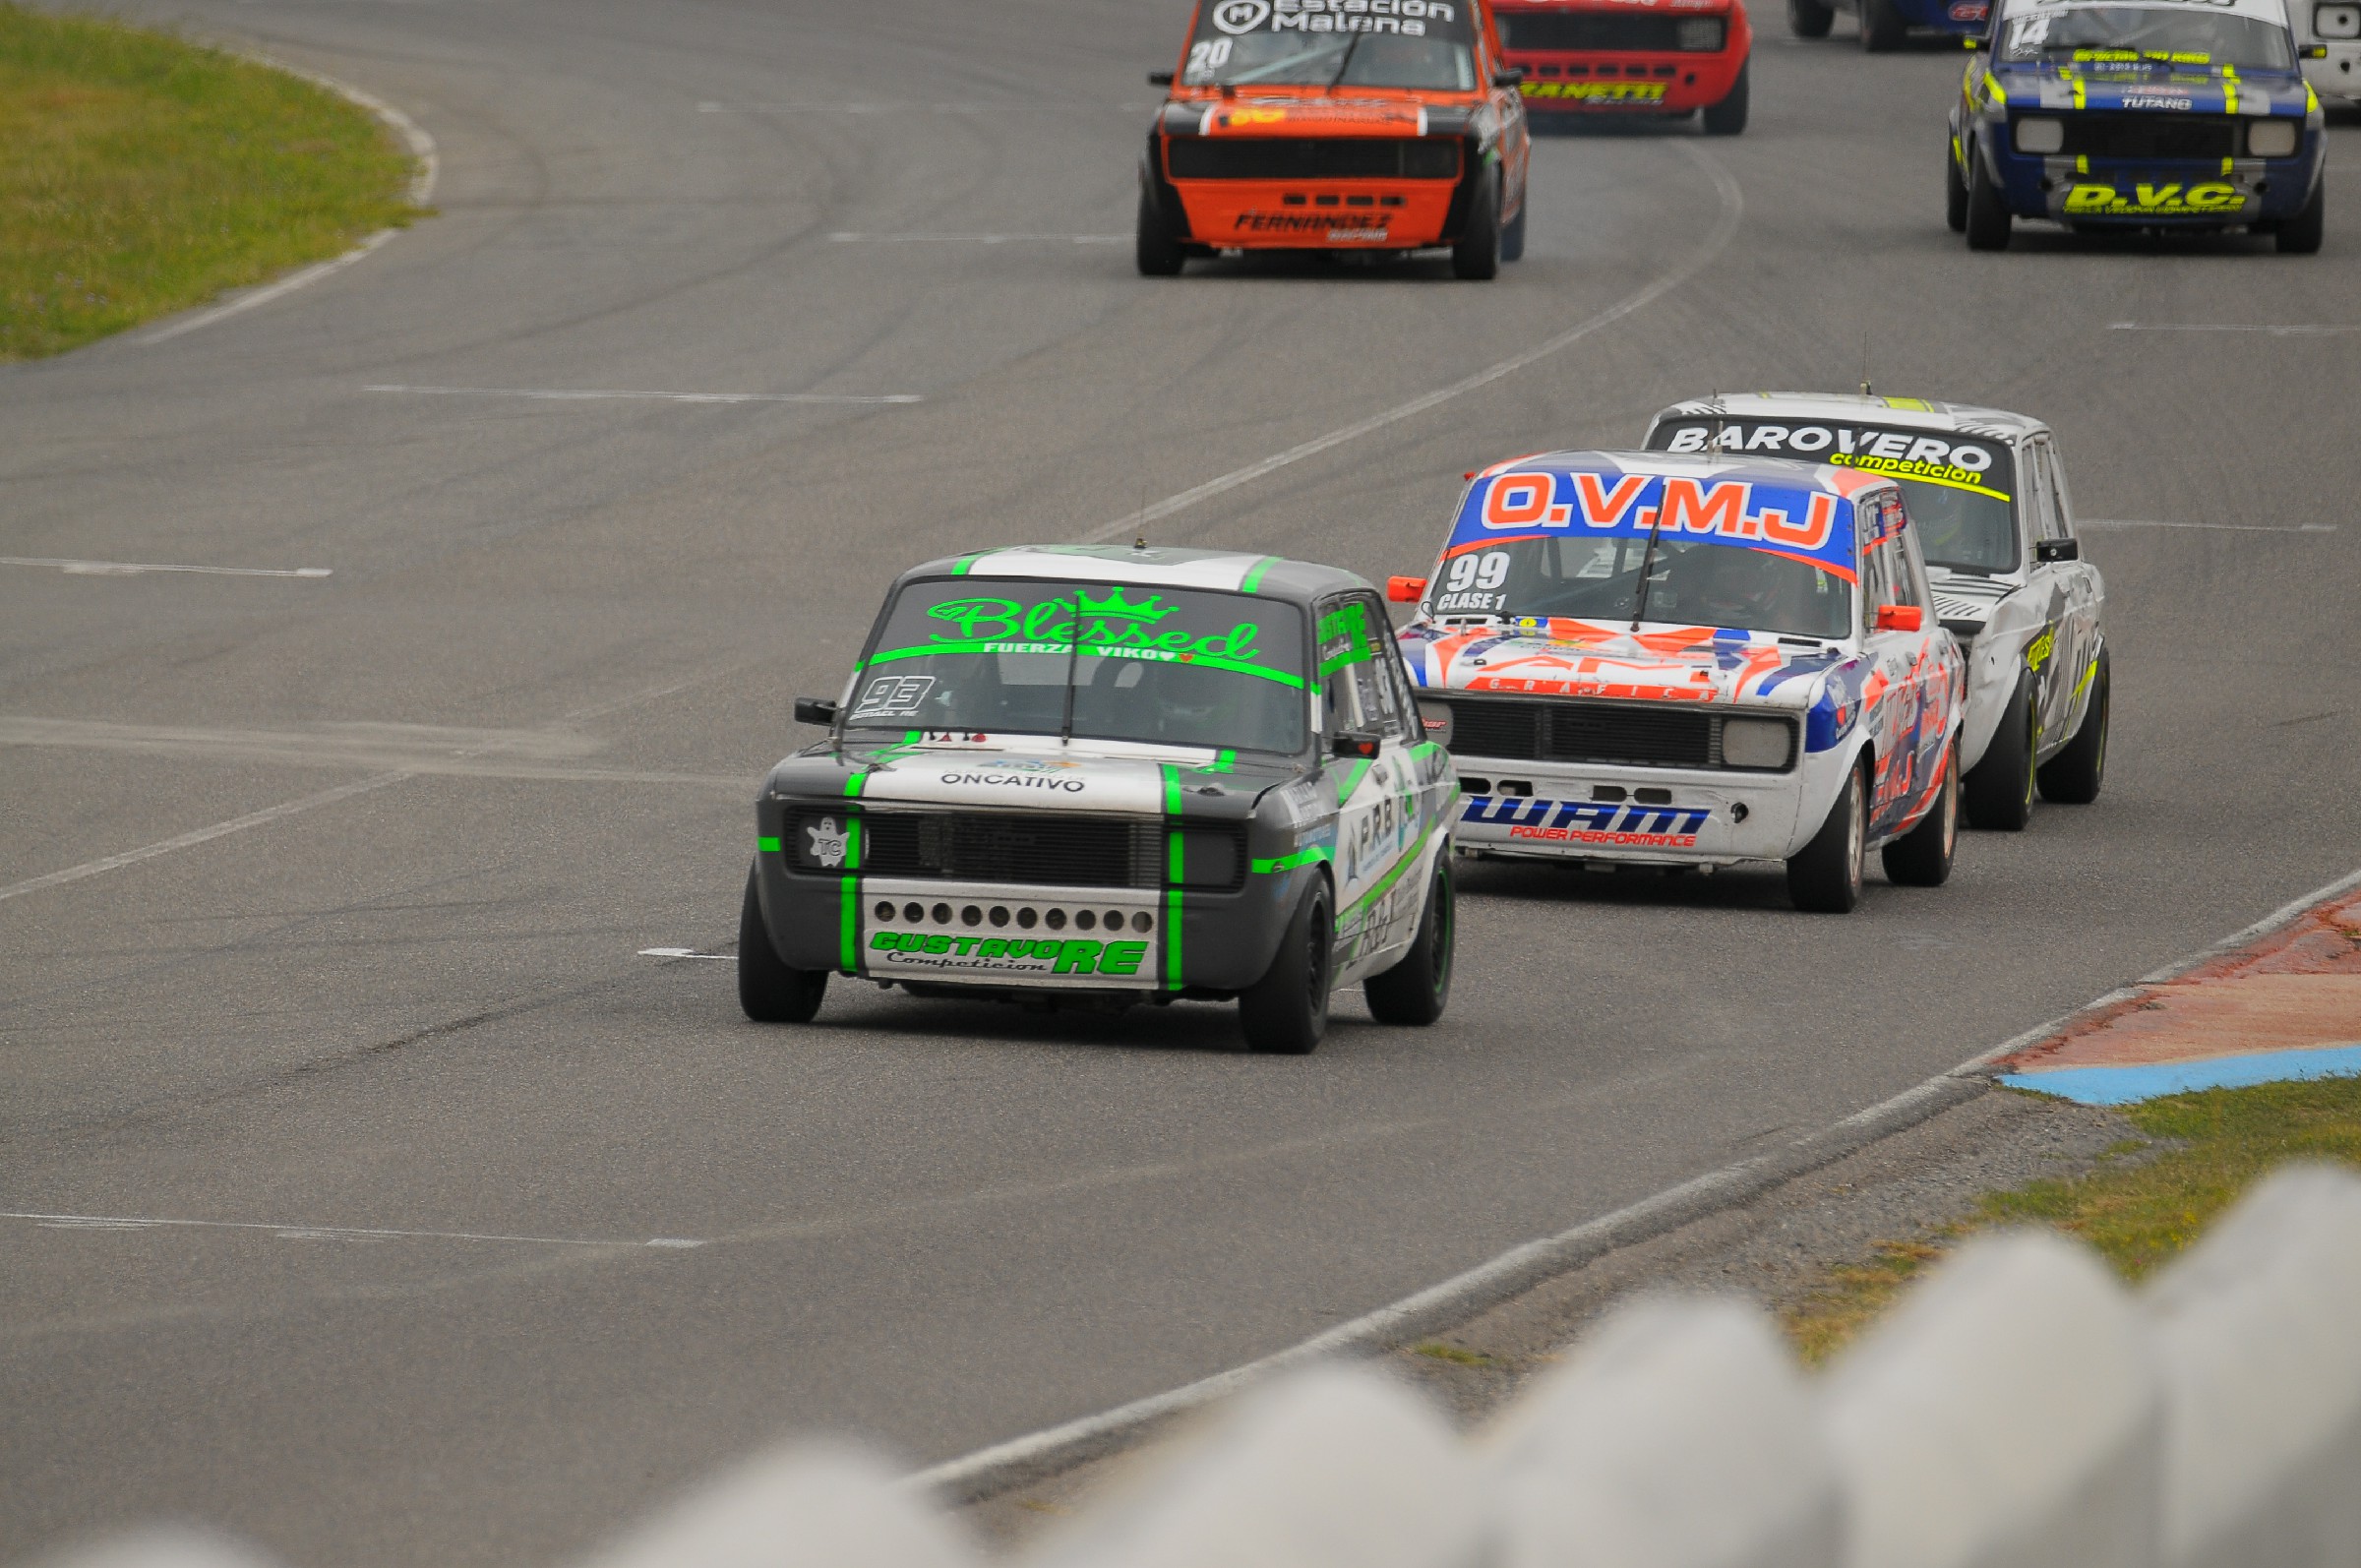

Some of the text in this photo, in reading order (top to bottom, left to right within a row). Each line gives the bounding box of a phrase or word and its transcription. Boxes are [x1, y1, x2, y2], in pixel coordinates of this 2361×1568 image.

[1271, 12, 1426, 36] Malena
[2009, 18, 2049, 49] 14
[1185, 38, 1233, 72] 20
[2122, 96, 2193, 110] TUTANO
[2066, 182, 2246, 208] D.V.C.
[1234, 213, 1394, 231] FERNANDEZ
[1666, 425, 1993, 473] BAROVERO
[1446, 551, 1511, 592] 99
[1436, 592, 1505, 612] CLASE 1
[928, 597, 1260, 661] Blessed
[984, 642, 1158, 660] FUERZA VIKO
[854, 675, 937, 714] 93
[940, 773, 1085, 793] ONCATIVO
[1460, 795, 1711, 834] WAM
[817, 838, 842, 857] TC
[1510, 825, 1697, 848] POWER PERFORMANCE
[886, 951, 1047, 972] Competicion
